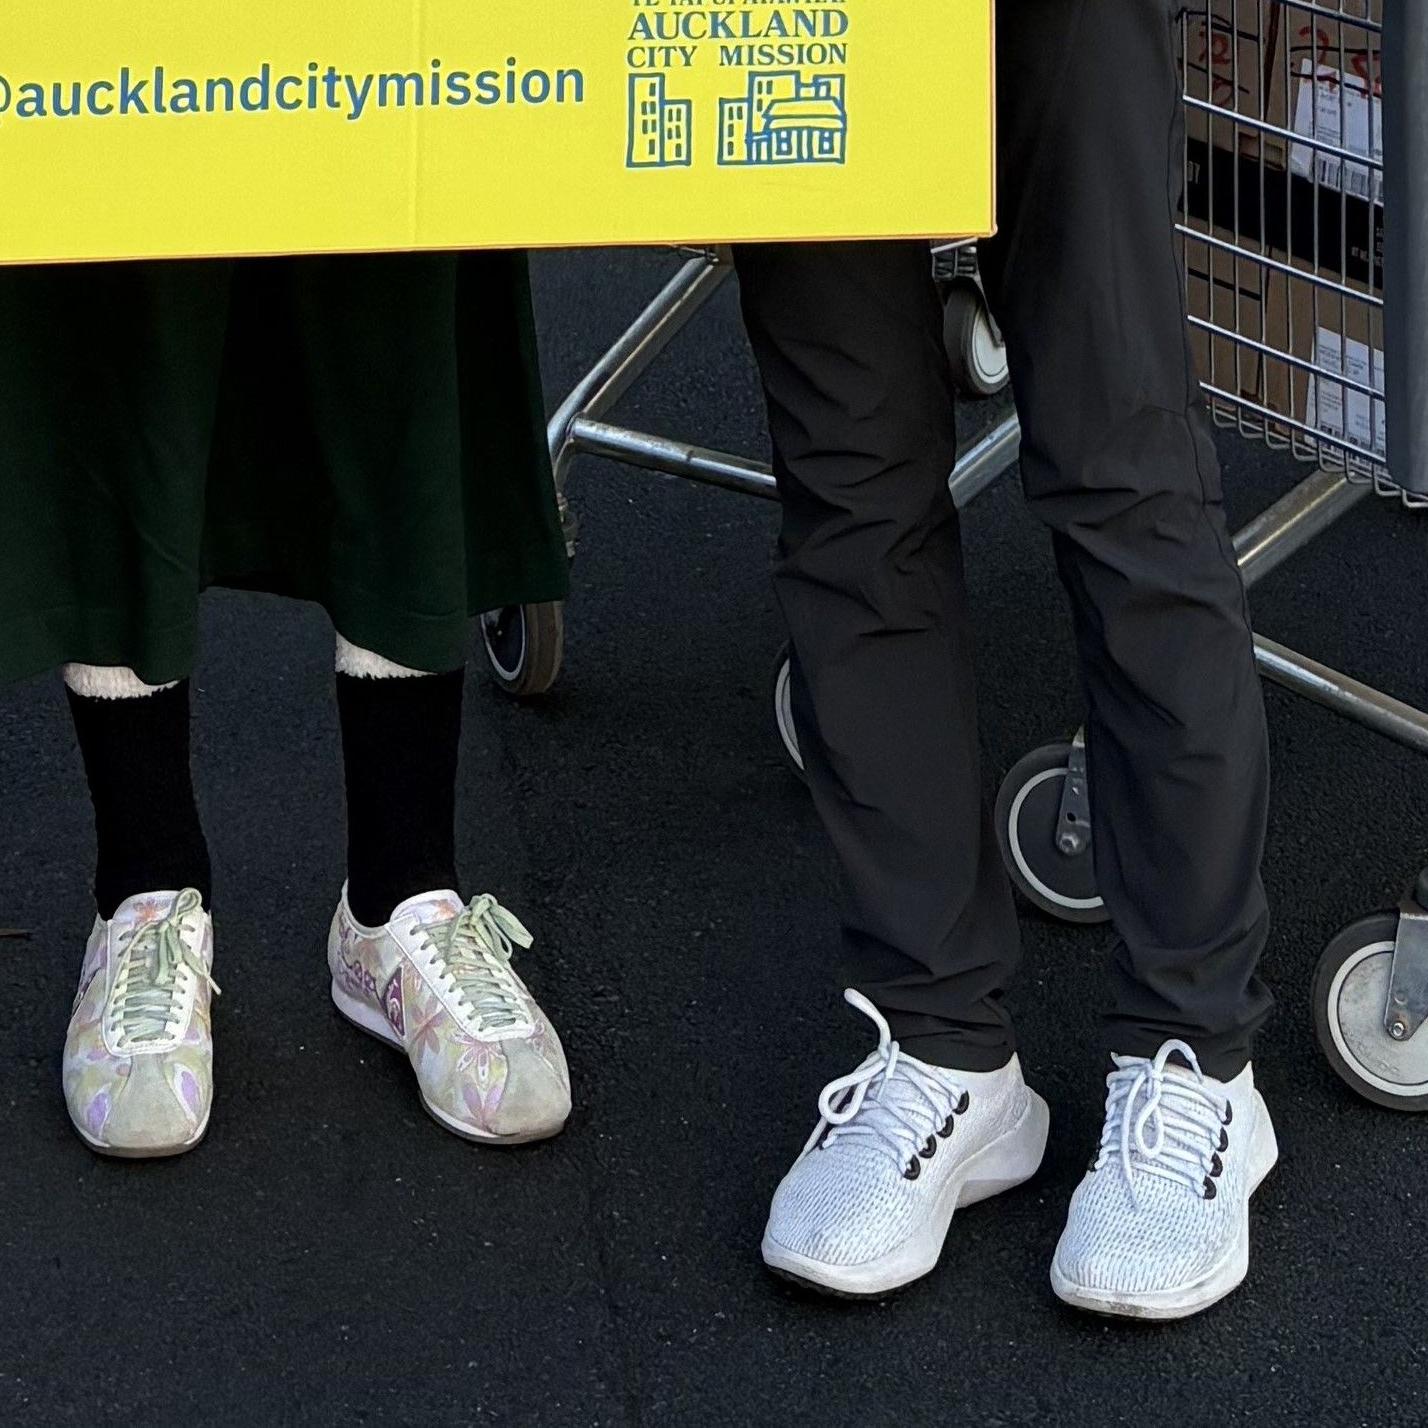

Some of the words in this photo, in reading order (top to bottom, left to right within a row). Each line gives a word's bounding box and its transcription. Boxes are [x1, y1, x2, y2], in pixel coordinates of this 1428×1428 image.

[627, 8, 849, 41] AUCKLAND
[626, 45, 698, 69] CITY
[719, 42, 849, 68] MISSION
